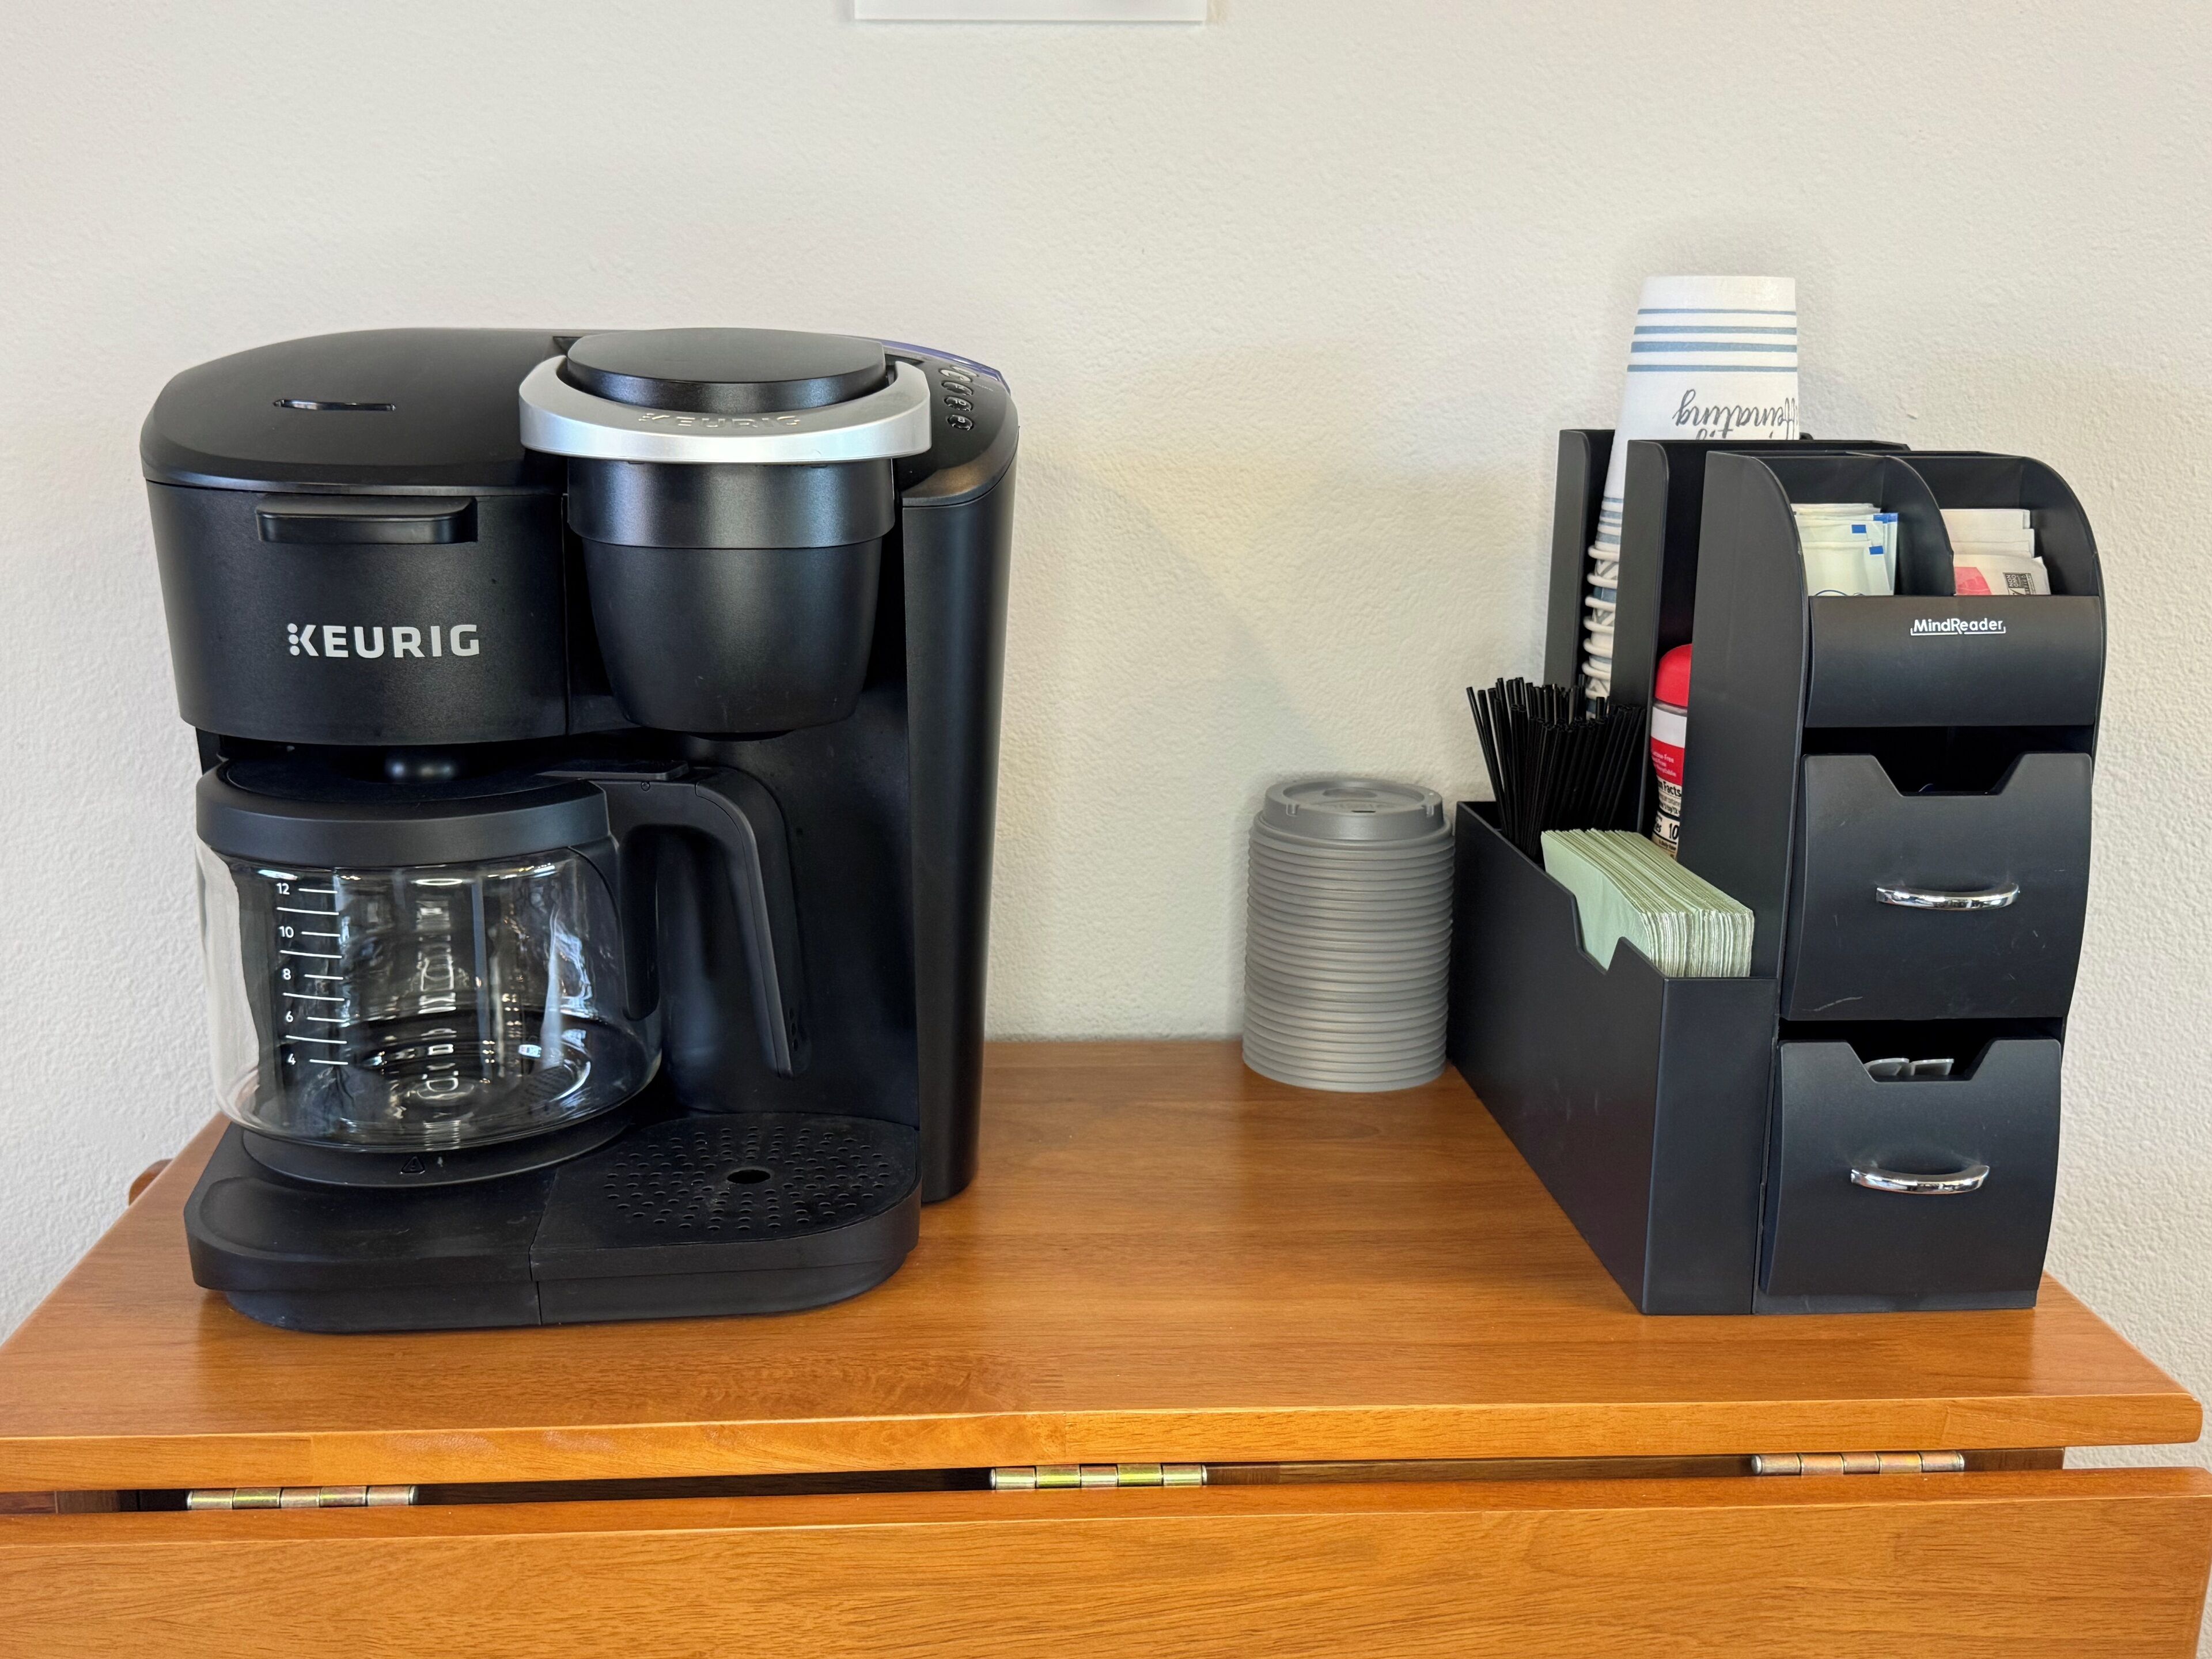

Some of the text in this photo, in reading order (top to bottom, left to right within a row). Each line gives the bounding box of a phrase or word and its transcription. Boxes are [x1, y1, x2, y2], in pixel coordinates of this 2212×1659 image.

[638, 413, 801, 427] KEURIG
[1672, 389, 1798, 440] ffeinating
[2006, 574, 2014, 587] NON
[1913, 618, 2004, 634] MindReader
[287, 623, 480, 658] KEURIG
[1663, 781, 1681, 797] Facts
[1669, 823, 1679, 840] 10
[276, 882, 290, 895] 12
[278, 926, 294, 938] 10
[283, 968, 291, 980] 8
[286, 1010, 294, 1022] 6
[288, 1053, 296, 1065] 4
